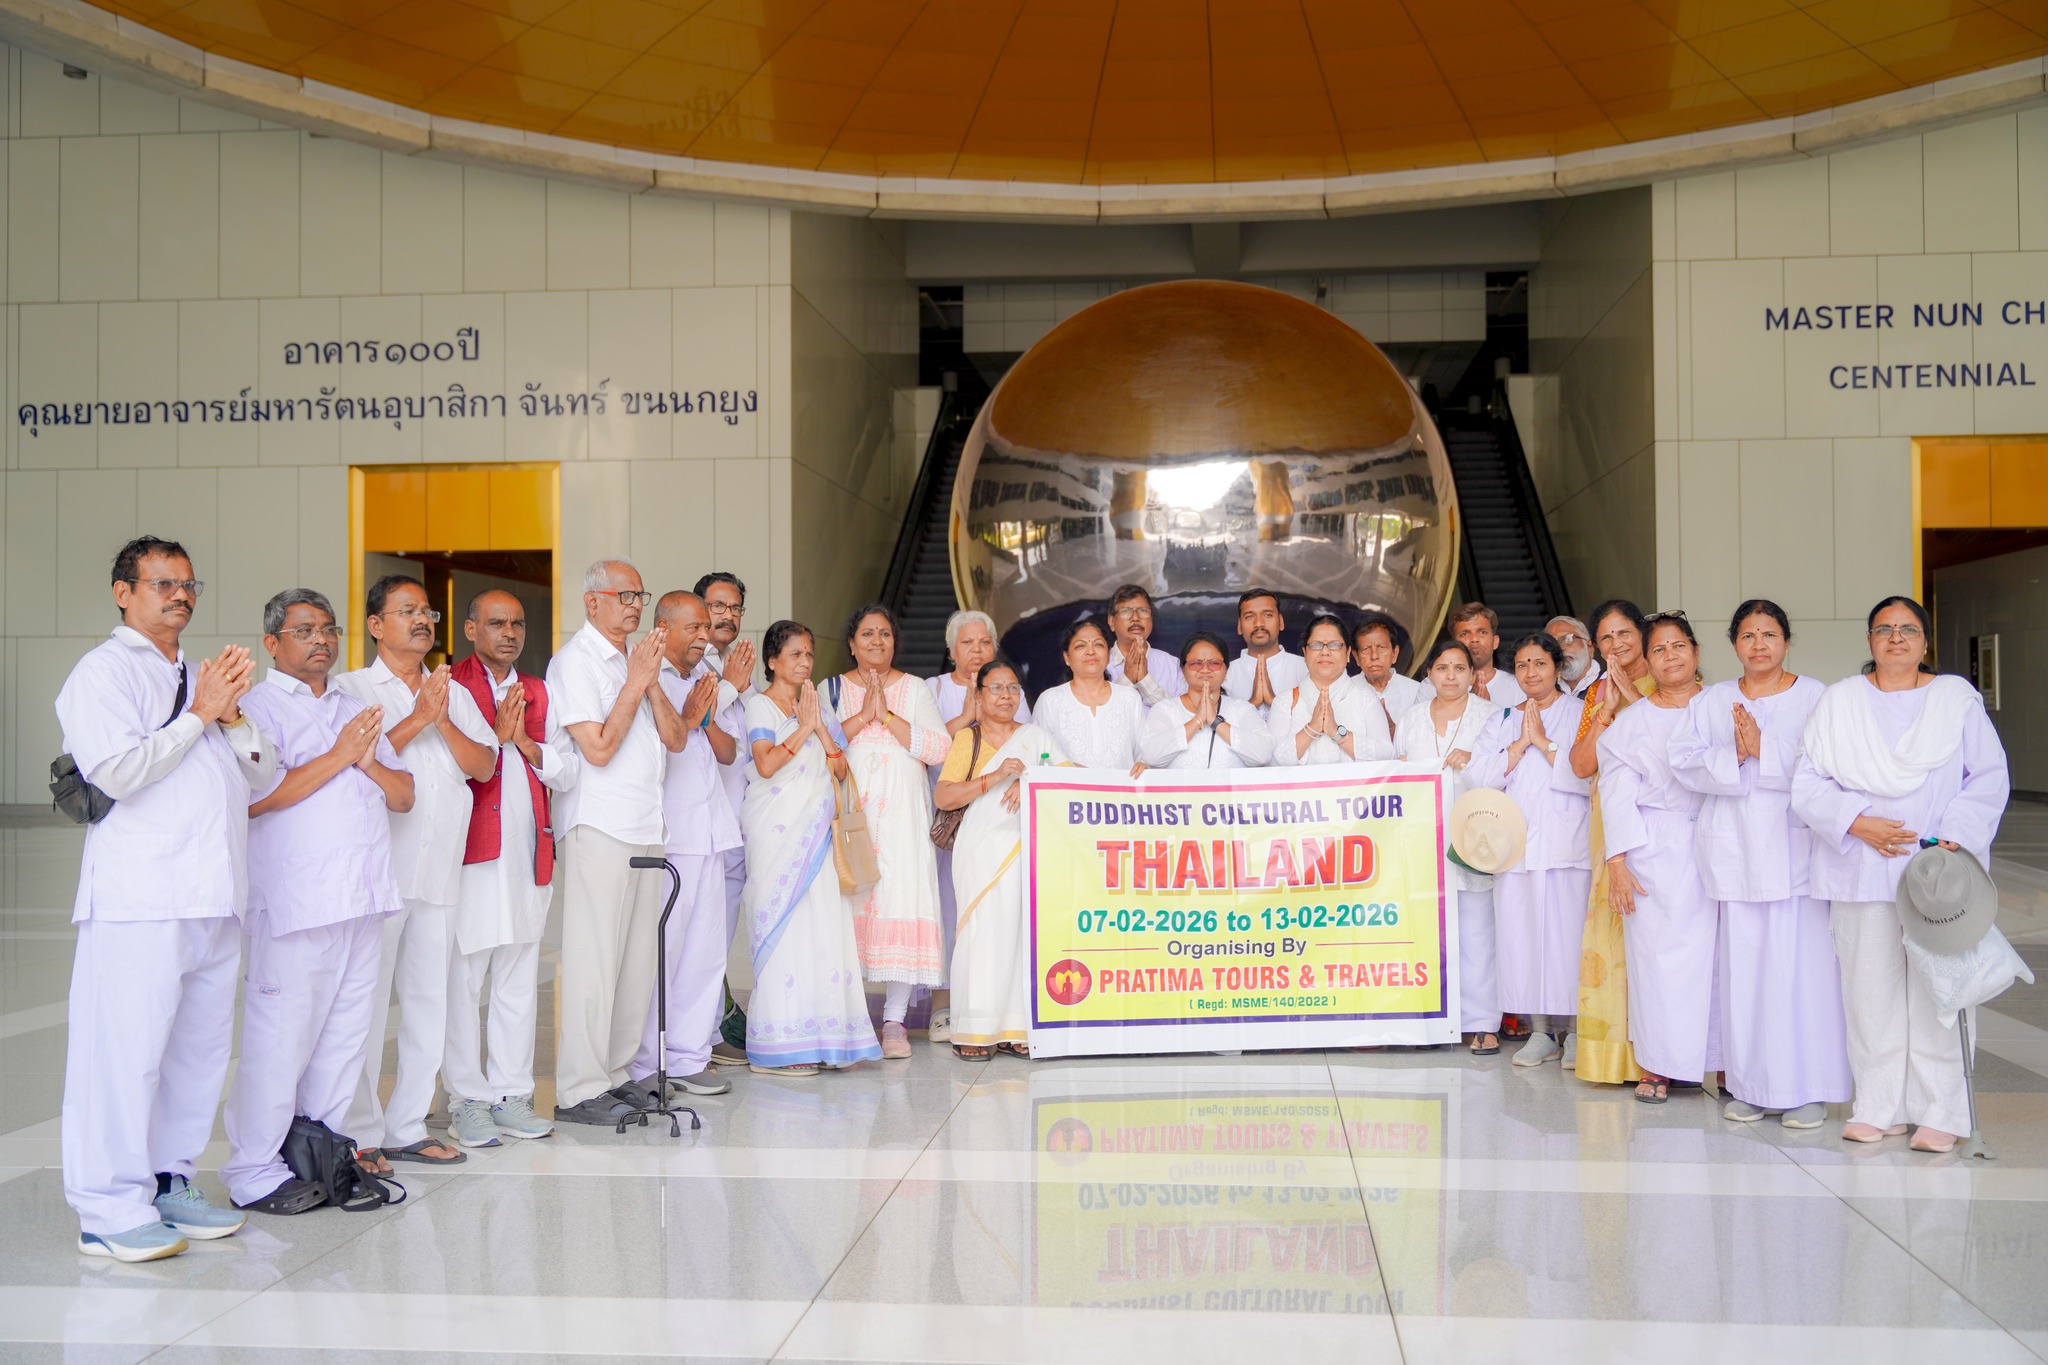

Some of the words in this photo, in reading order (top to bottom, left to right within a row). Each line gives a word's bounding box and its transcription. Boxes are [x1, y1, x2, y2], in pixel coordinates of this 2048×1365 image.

[1765, 305, 1894, 331] MASTER
[1913, 302, 1982, 328] NUN
[2001, 300, 2045, 325] CH
[284, 326, 480, 365] อาคาร๑๐๐ปี
[1829, 362, 2036, 389] CENTENNIAL
[18, 384, 506, 437] คุณยายอาจารย์มหารัตนอุบาสิกา
[519, 378, 610, 416] จันทร์
[620, 389, 758, 426] ขนนกยูง
[1068, 801, 1192, 826] BUDDHIST
[1202, 800, 1330, 826] CULTURAL
[1337, 794, 1403, 819] TOUR
[1096, 834, 1379, 894] THAILAND
[1077, 908, 1218, 933] 07-02-2026
[1227, 908, 1251, 932] to
[1261, 903, 1399, 930] 13-02-2026
[1166, 939, 1276, 959] Organising
[1282, 938, 1307, 957] By
[1099, 967, 1204, 994] PRATIMA
[1212, 964, 1290, 991] TOURS
[1298, 965, 1316, 989] &
[1324, 962, 1428, 988] TRAVELS
[1197, 998, 1228, 1011] Regd:
[1231, 996, 1329, 1009] MSME/140/2022
